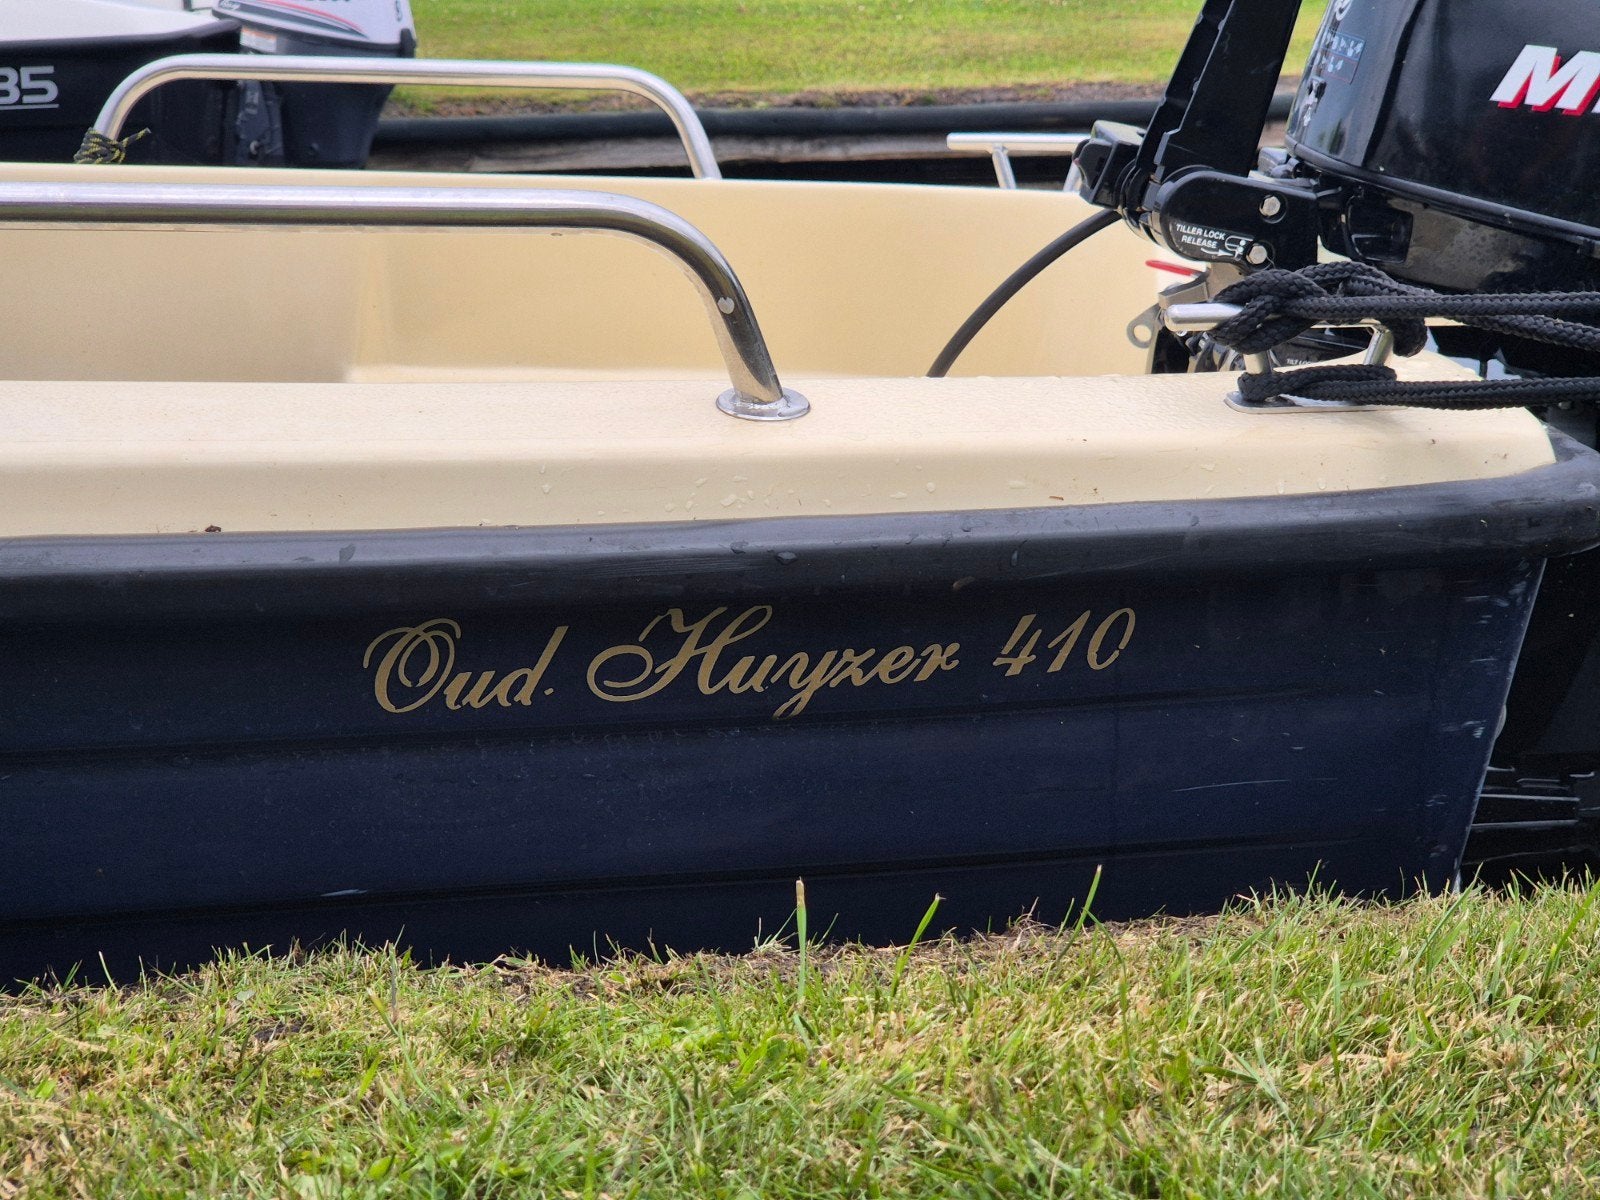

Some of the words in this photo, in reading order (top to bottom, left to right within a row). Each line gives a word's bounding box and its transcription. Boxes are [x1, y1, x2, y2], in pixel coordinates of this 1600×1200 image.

[1489, 44, 1600, 116] M
[1176, 223, 1203, 236] TILLER
[1203, 229, 1226, 240] LOCK
[1181, 235, 1218, 249] RELEASE
[362, 617, 569, 714] Oud.
[586, 604, 961, 720] Huyzer
[992, 607, 1136, 677] 410
